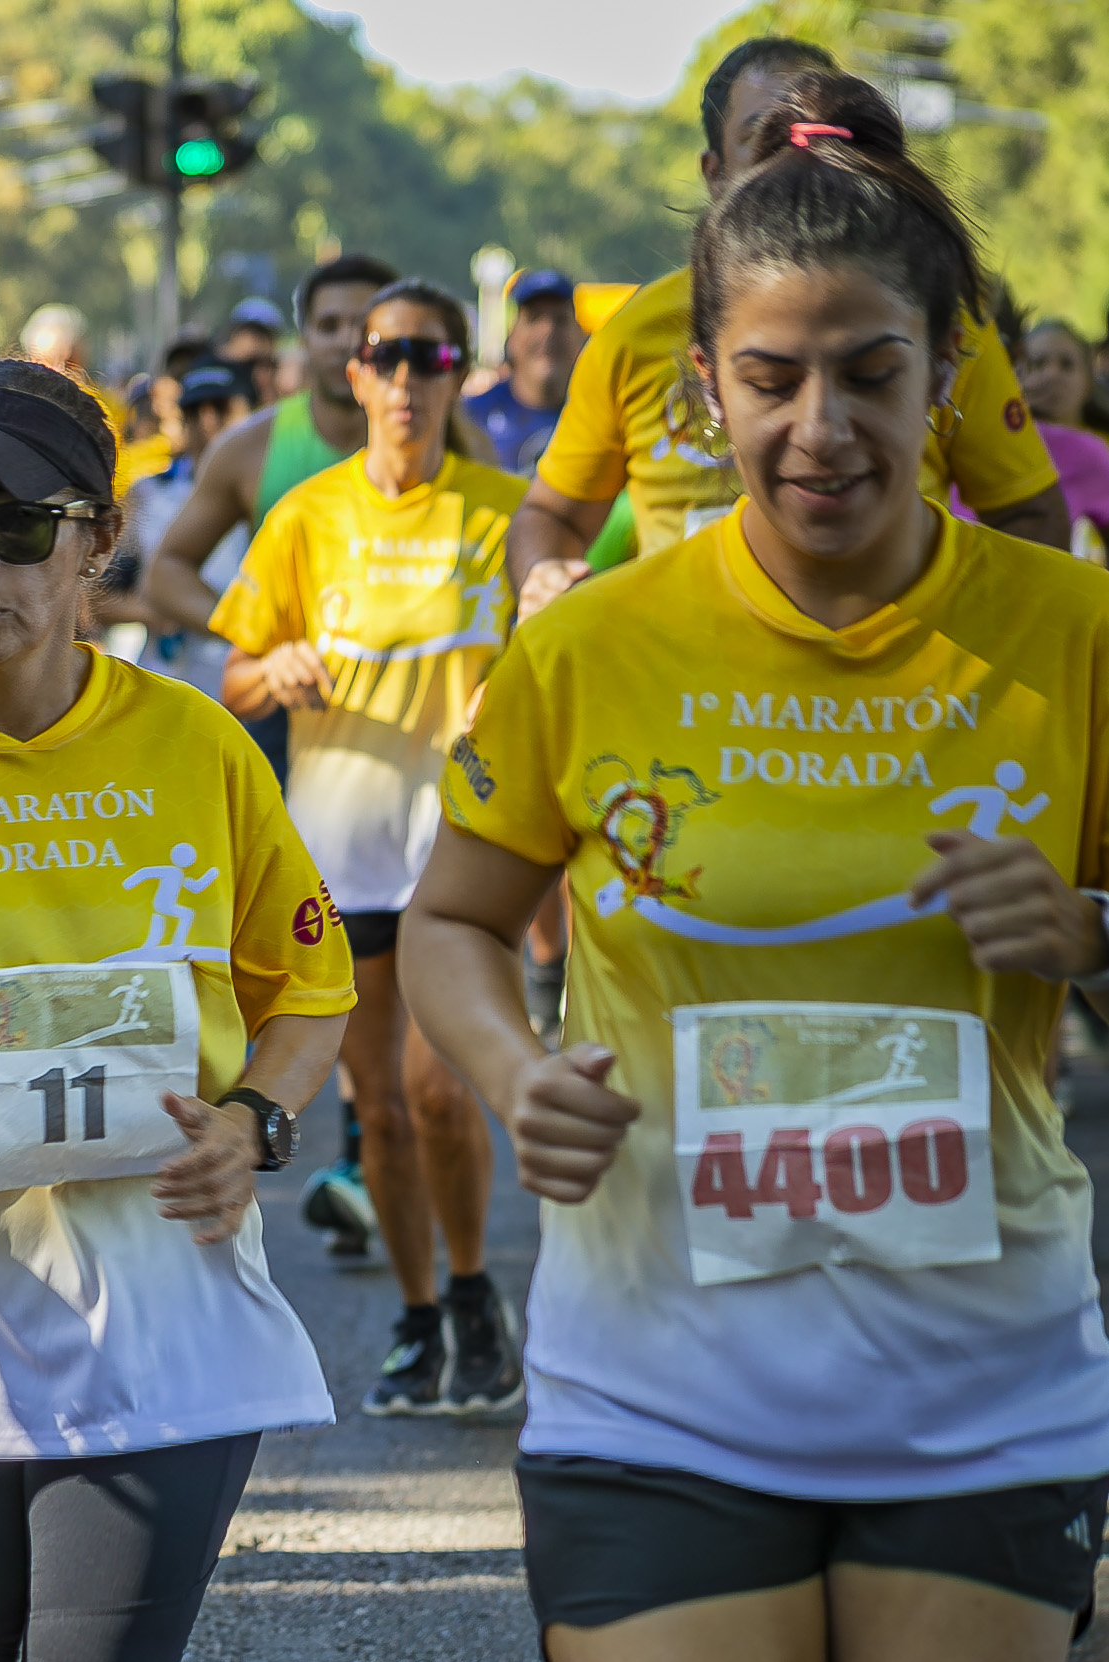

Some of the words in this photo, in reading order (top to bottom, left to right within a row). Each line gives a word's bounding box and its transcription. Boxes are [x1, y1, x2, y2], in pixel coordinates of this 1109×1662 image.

[728, 685, 982, 733] MARATÓN
[718, 746, 936, 787] DORADA
[27, 1064, 107, 1144] 11
[691, 1117, 969, 1220] 4400
